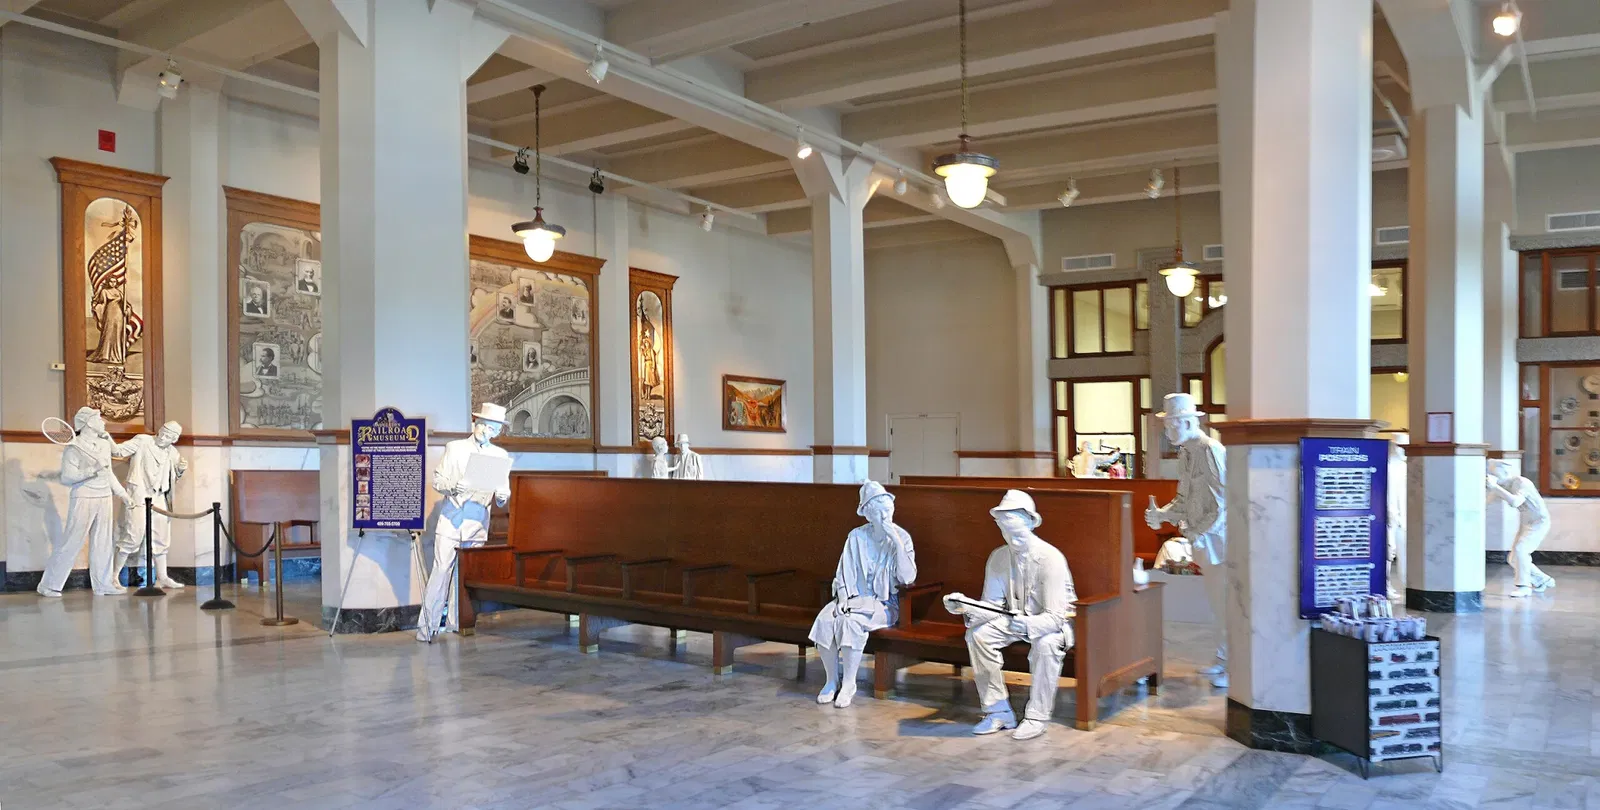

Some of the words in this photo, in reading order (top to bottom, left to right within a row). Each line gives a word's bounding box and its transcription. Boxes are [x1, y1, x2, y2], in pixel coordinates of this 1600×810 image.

[358, 425, 420, 443] RAILROAD
[372, 434, 406, 442] MUSEUM
[1328, 446, 1360, 454] TRAIN
[1318, 453, 1369, 462] POSTERS
